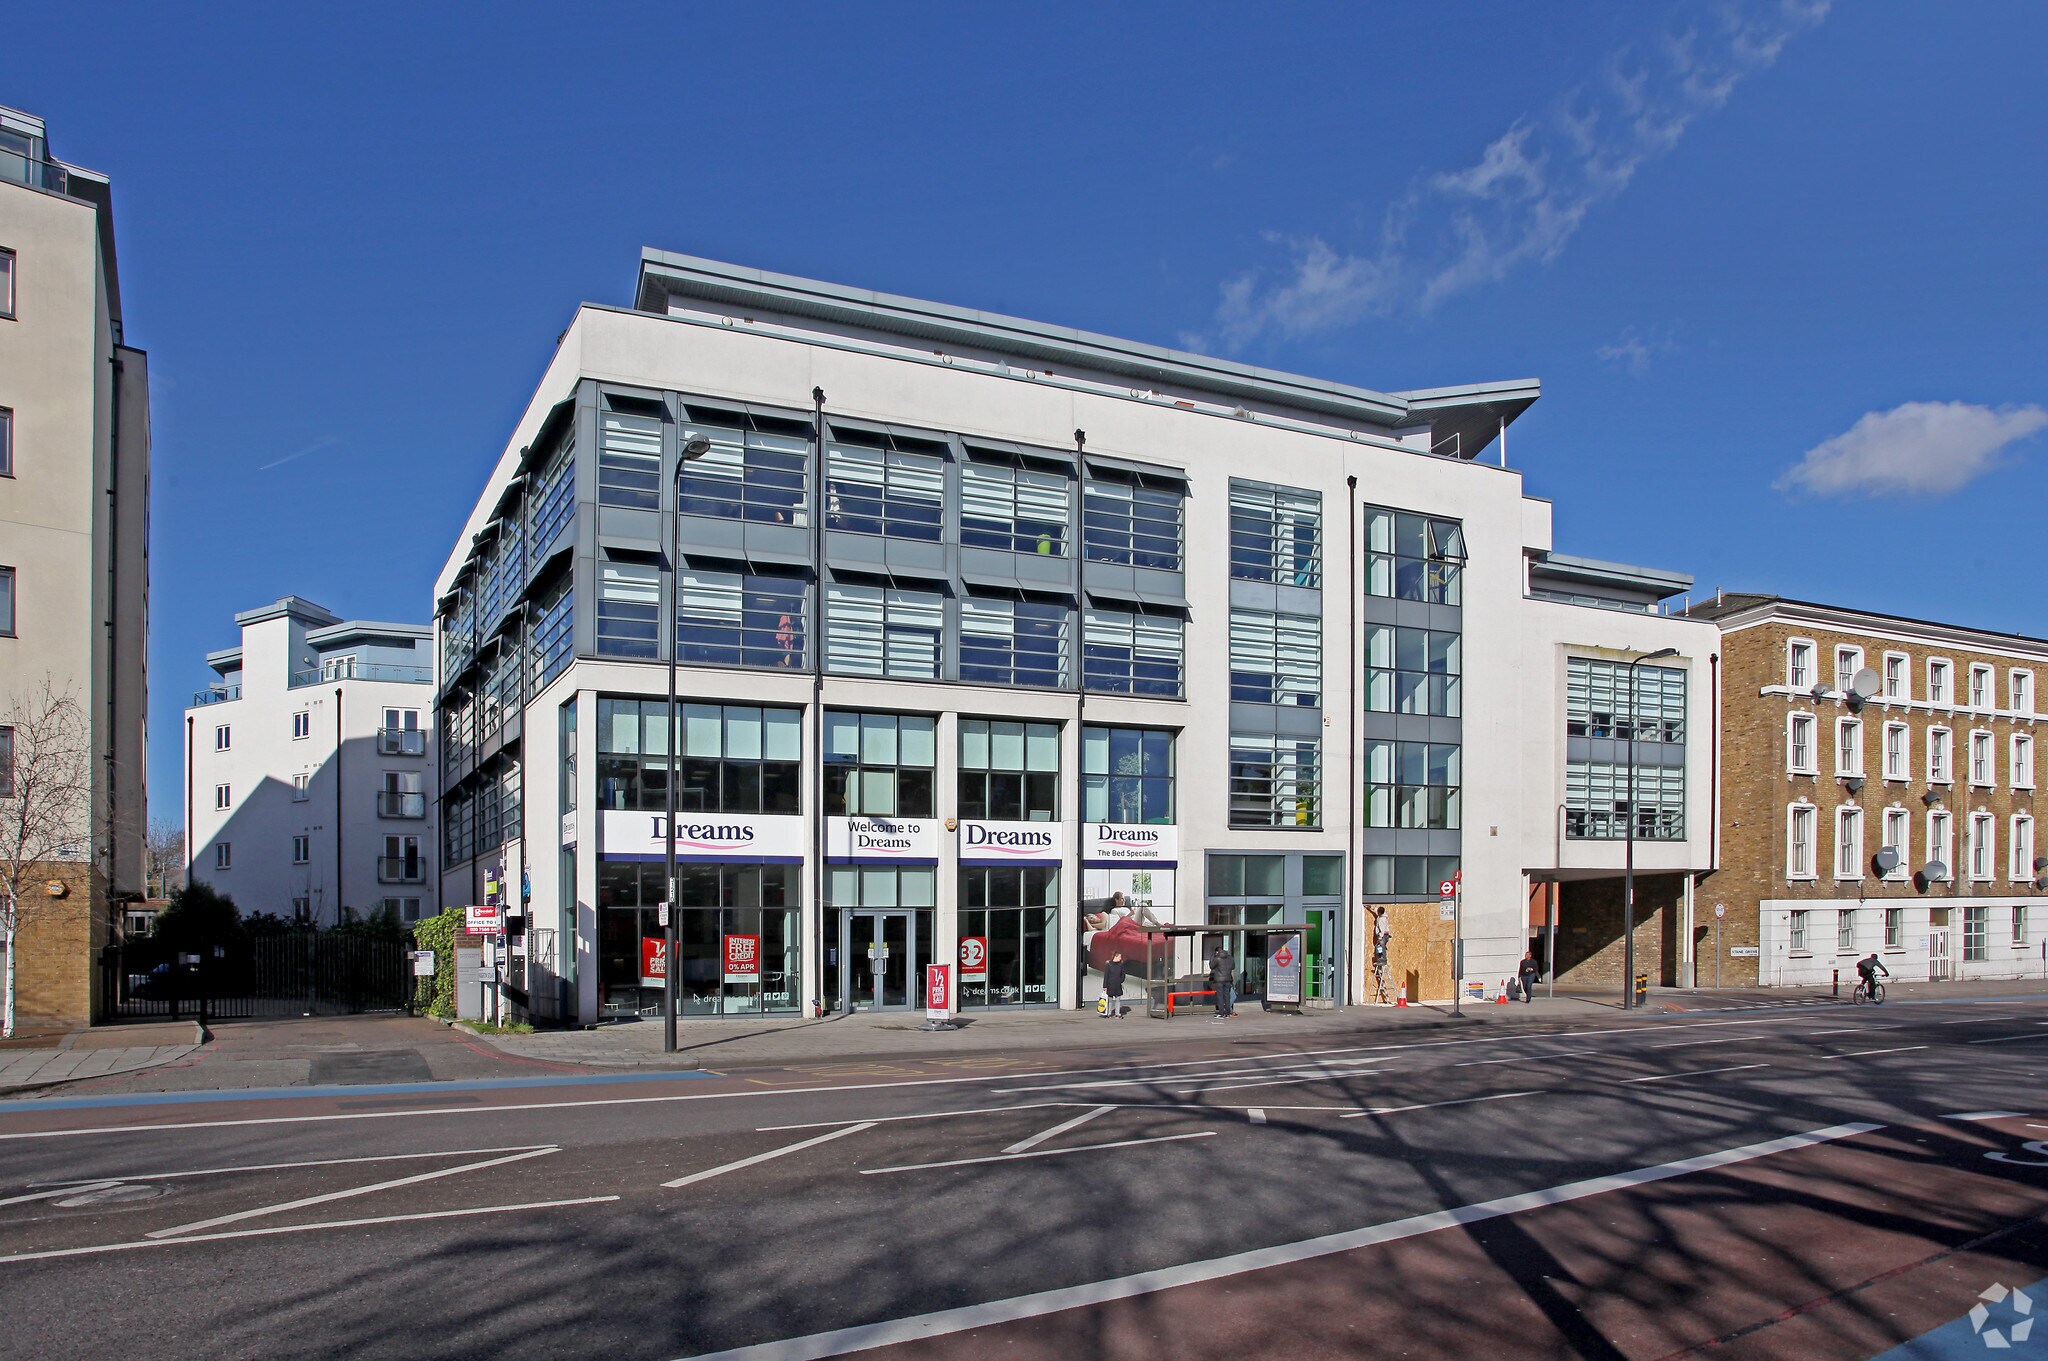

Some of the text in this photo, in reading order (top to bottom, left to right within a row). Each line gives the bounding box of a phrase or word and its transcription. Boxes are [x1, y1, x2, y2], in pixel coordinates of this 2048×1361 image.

[651, 816, 754, 840] Dreams
[847, 821, 921, 833] Welcome to
[966, 824, 1052, 846] Dreams
[1098, 825, 1158, 841] Dreams
[857, 834, 911, 848] Dreams
[1097, 849, 1158, 858] The Bed Specialist
[1454, 871, 1459, 879] J
[728, 937, 756, 945] INTEREST
[729, 943, 755, 954] FREE
[973, 945, 982, 960] 2
[729, 952, 755, 961] CREDIT
[740, 963, 755, 971] APR
